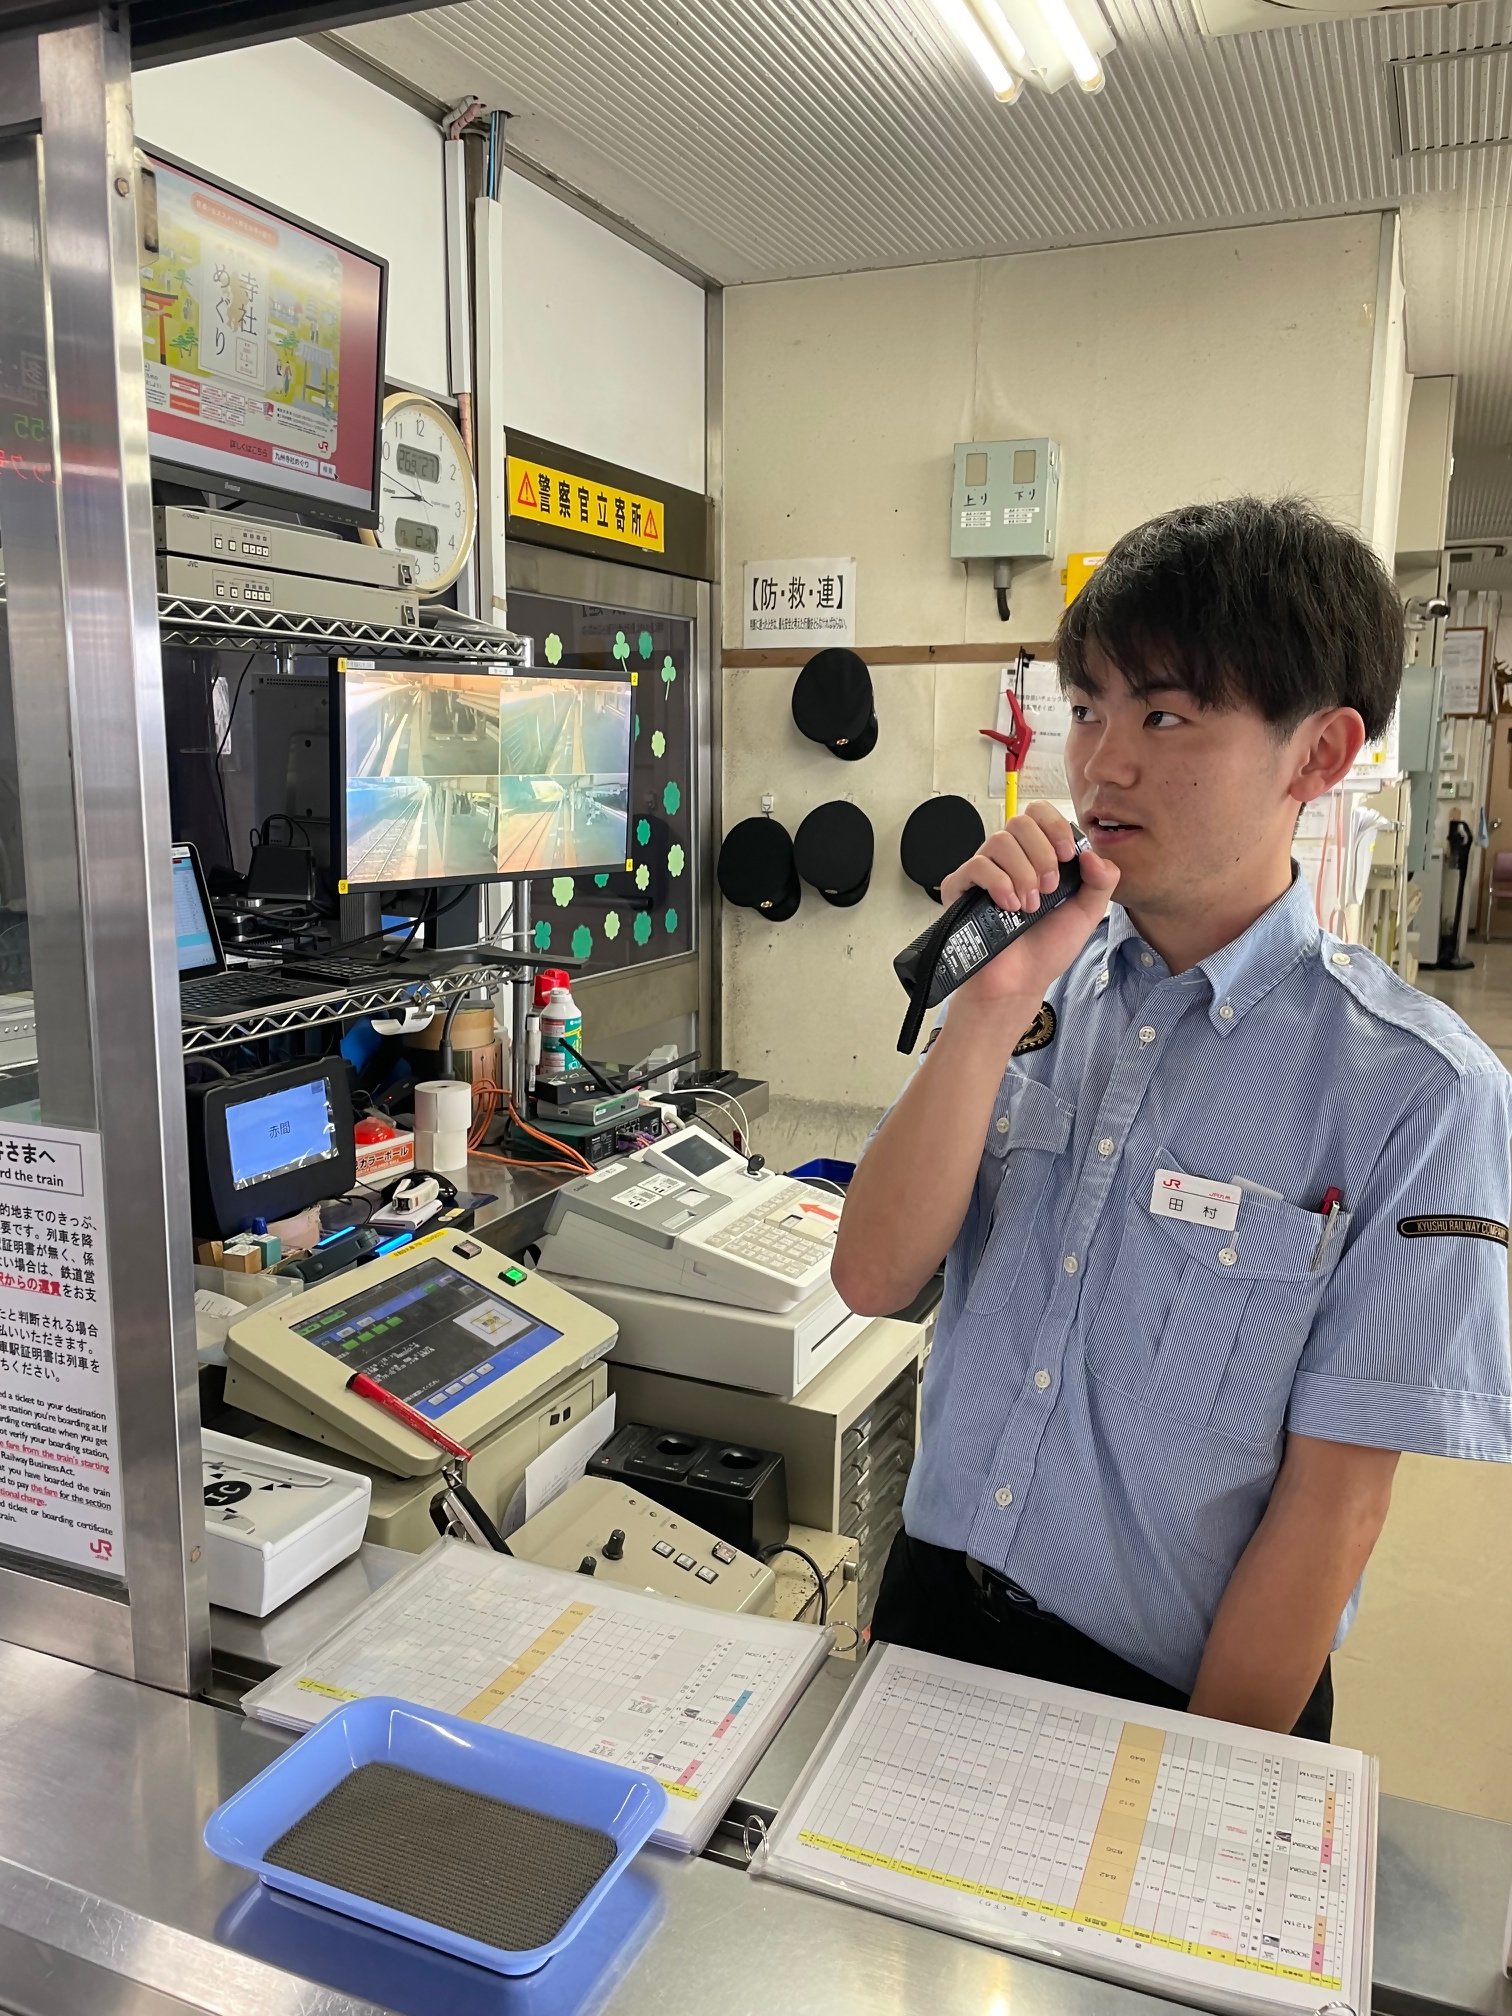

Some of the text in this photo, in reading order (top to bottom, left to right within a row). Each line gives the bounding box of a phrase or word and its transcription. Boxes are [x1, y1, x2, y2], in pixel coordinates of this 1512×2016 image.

[213, 263, 230, 356] めぐり
[238, 272, 258, 336] 寺社
[395, 421, 403, 439] 11
[416, 419, 425, 437] 12
[538, 473, 642, 537] 警察官立寄所
[269, 1121, 290, 1138] 赤間
[15, 1170, 33, 1182] the
[37, 1174, 64, 1187] train
[1163, 1178, 1181, 1189] JR
[1417, 1221, 1448, 1231] KYUSHU
[1449, 1221, 1480, 1232] RAILWAY
[8, 1405, 32, 1416] station
[34, 1411, 56, 1422] you're
[57, 1415, 90, 1432] boarding
[101, 1424, 107, 1433] If
[15, 1394, 35, 1405] ticket
[37, 1399, 44, 1407] to
[47, 1402, 63, 1411] your
[65, 1405, 107, 1420] destination
[9, 1431, 28, 1442] verify
[30, 1435, 46, 1443] your
[48, 1438, 80, 1454] boarding
[21, 1420, 57, 1434] certificate
[58, 1429, 78, 1439] when
[80, 1434, 93, 1443] you
[95, 1437, 107, 1446] get
[1, 1451, 28, 1466] Railway
[29, 1458, 59, 1473] Business
[6, 1440, 20, 1451] fare
[22, 1444, 39, 1456] from
[42, 1449, 54, 1458] the
[56, 1452, 78, 1465] train's
[81, 1459, 109, 1474] starting
[8, 1467, 21, 1475] you
[24, 1469, 41, 1480] have
[44, 1474, 74, 1488] boarded
[77, 1483, 89, 1492] the
[93, 1487, 110, 1497] train
[8, 1478, 15, 1486] to
[17, 1481, 29, 1491] pay
[31, 1484, 42, 1493] the
[44, 1486, 58, 1497] fare
[60, 1490, 70, 1499] for
[71, 1494, 84, 1504] the
[85, 1498, 111, 1511] section
[205, 1484, 241, 1505] IC
[8, 1502, 28, 1514] ticket
[42, 1510, 73, 1527] boarding
[76, 1521, 113, 1536] certificate
[90, 1539, 112, 1557] JR
